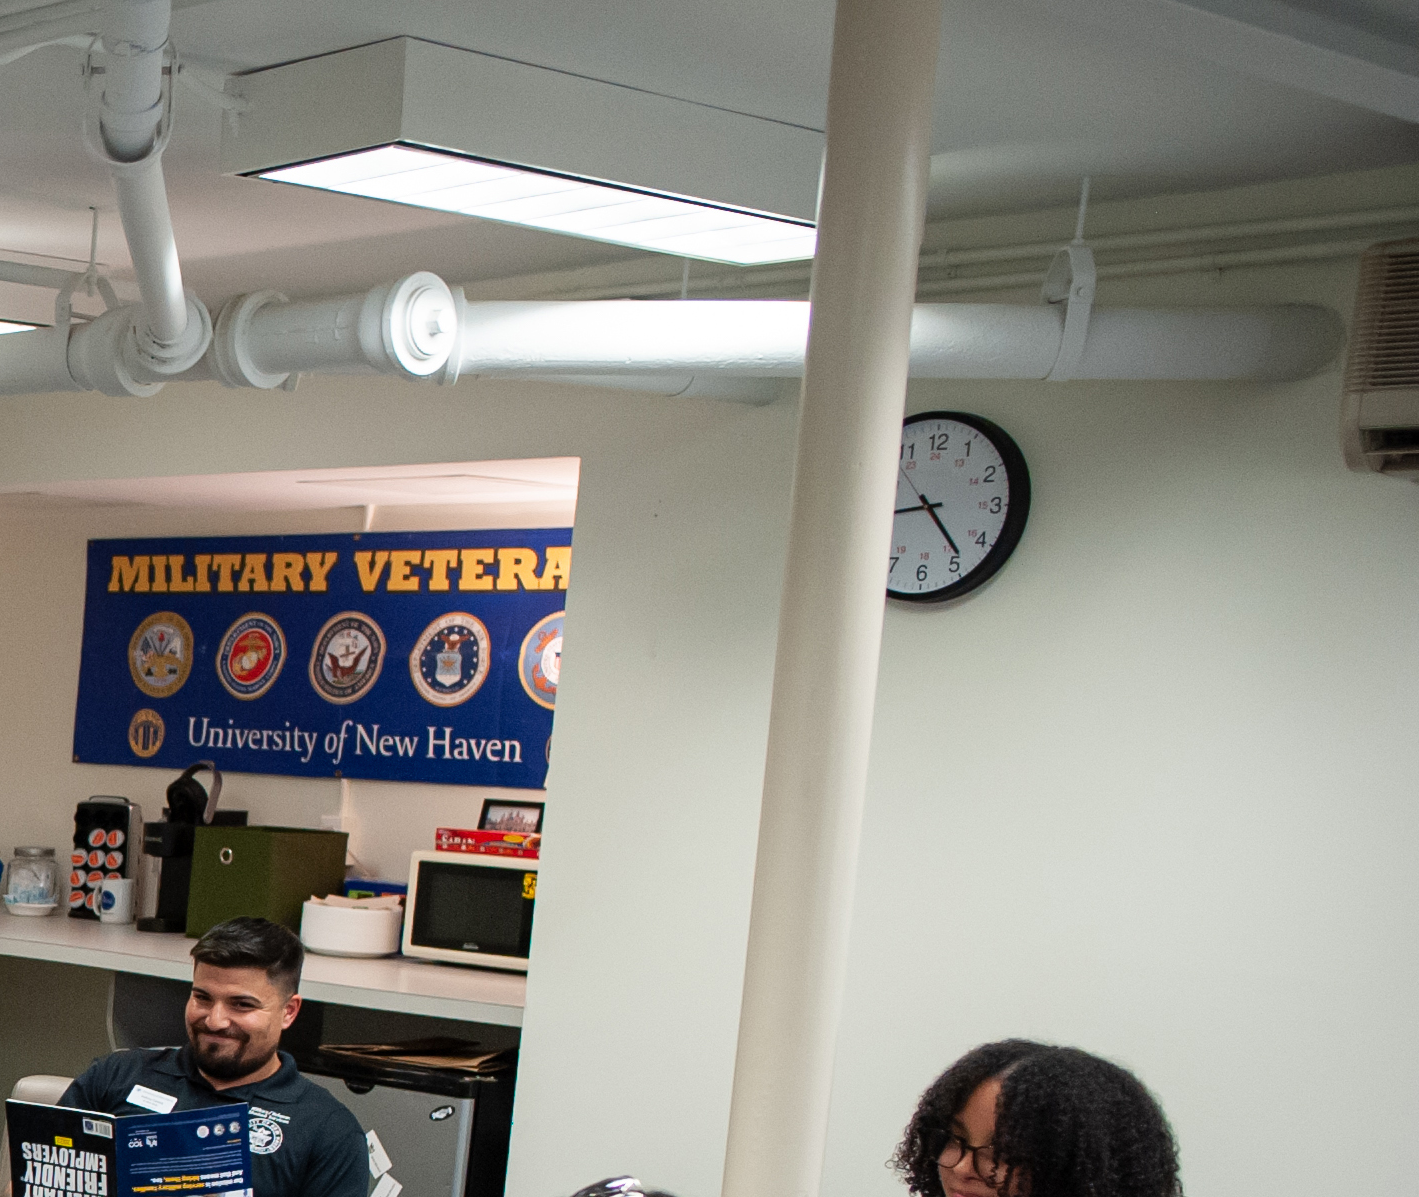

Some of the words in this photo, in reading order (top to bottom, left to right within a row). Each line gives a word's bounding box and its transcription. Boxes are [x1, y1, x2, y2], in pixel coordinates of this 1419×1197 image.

[928, 433, 949, 451] 12
[964, 440, 972, 457] 1
[983, 466, 996, 483] 2
[989, 496, 1002, 514] 3
[975, 531, 987, 548] 4
[107, 552, 338, 594] MILITARY
[353, 546, 571, 592] VETERA
[916, 564, 928, 582] 6
[948, 555, 960, 573] 5
[188, 716, 318, 764] University
[324, 719, 348, 765] of
[355, 723, 419, 760] New
[426, 726, 522, 763] Haven
[21, 1141, 107, 1173] EMPLOYERS
